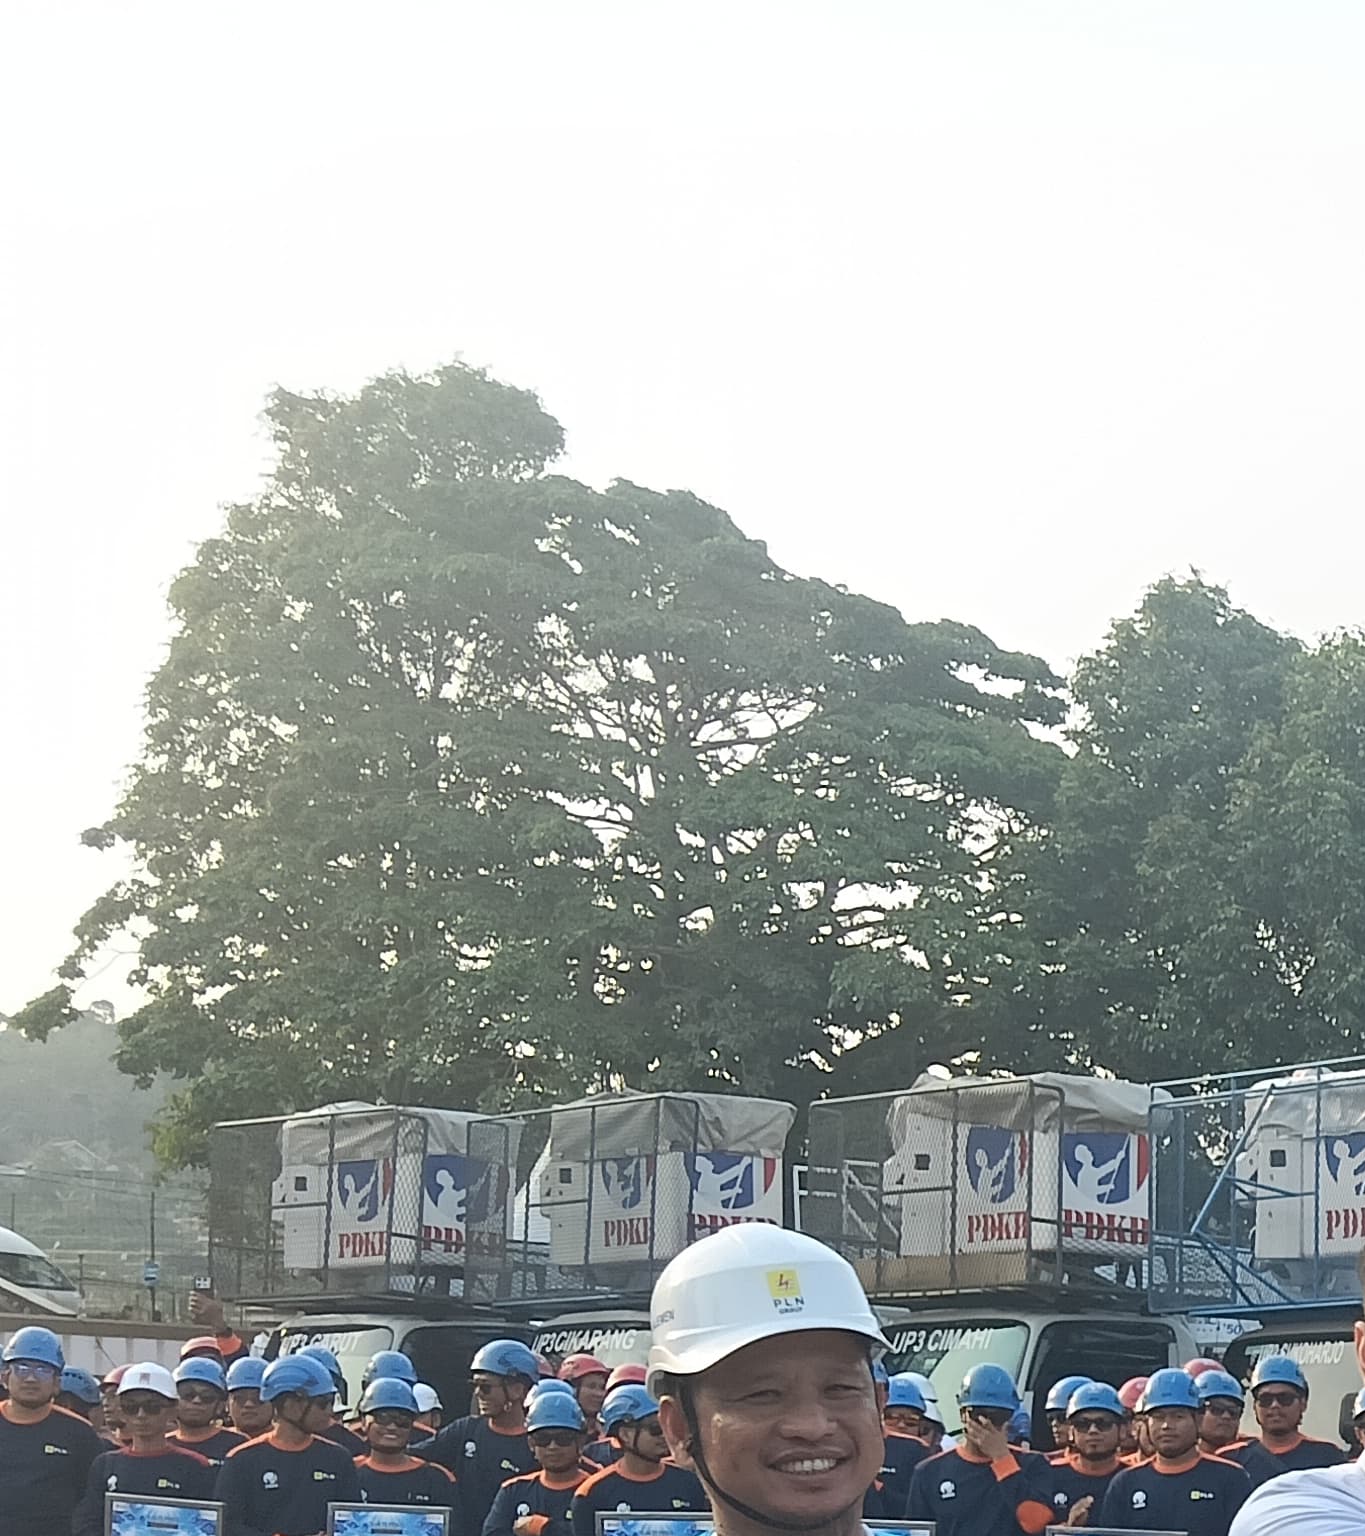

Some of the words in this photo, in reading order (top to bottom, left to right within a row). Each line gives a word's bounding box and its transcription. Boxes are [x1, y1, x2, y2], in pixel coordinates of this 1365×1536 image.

[773, 1296, 805, 1308] PLN
[893, 1330, 926, 1356] UP3
[928, 1327, 991, 1352] CIMAHI
